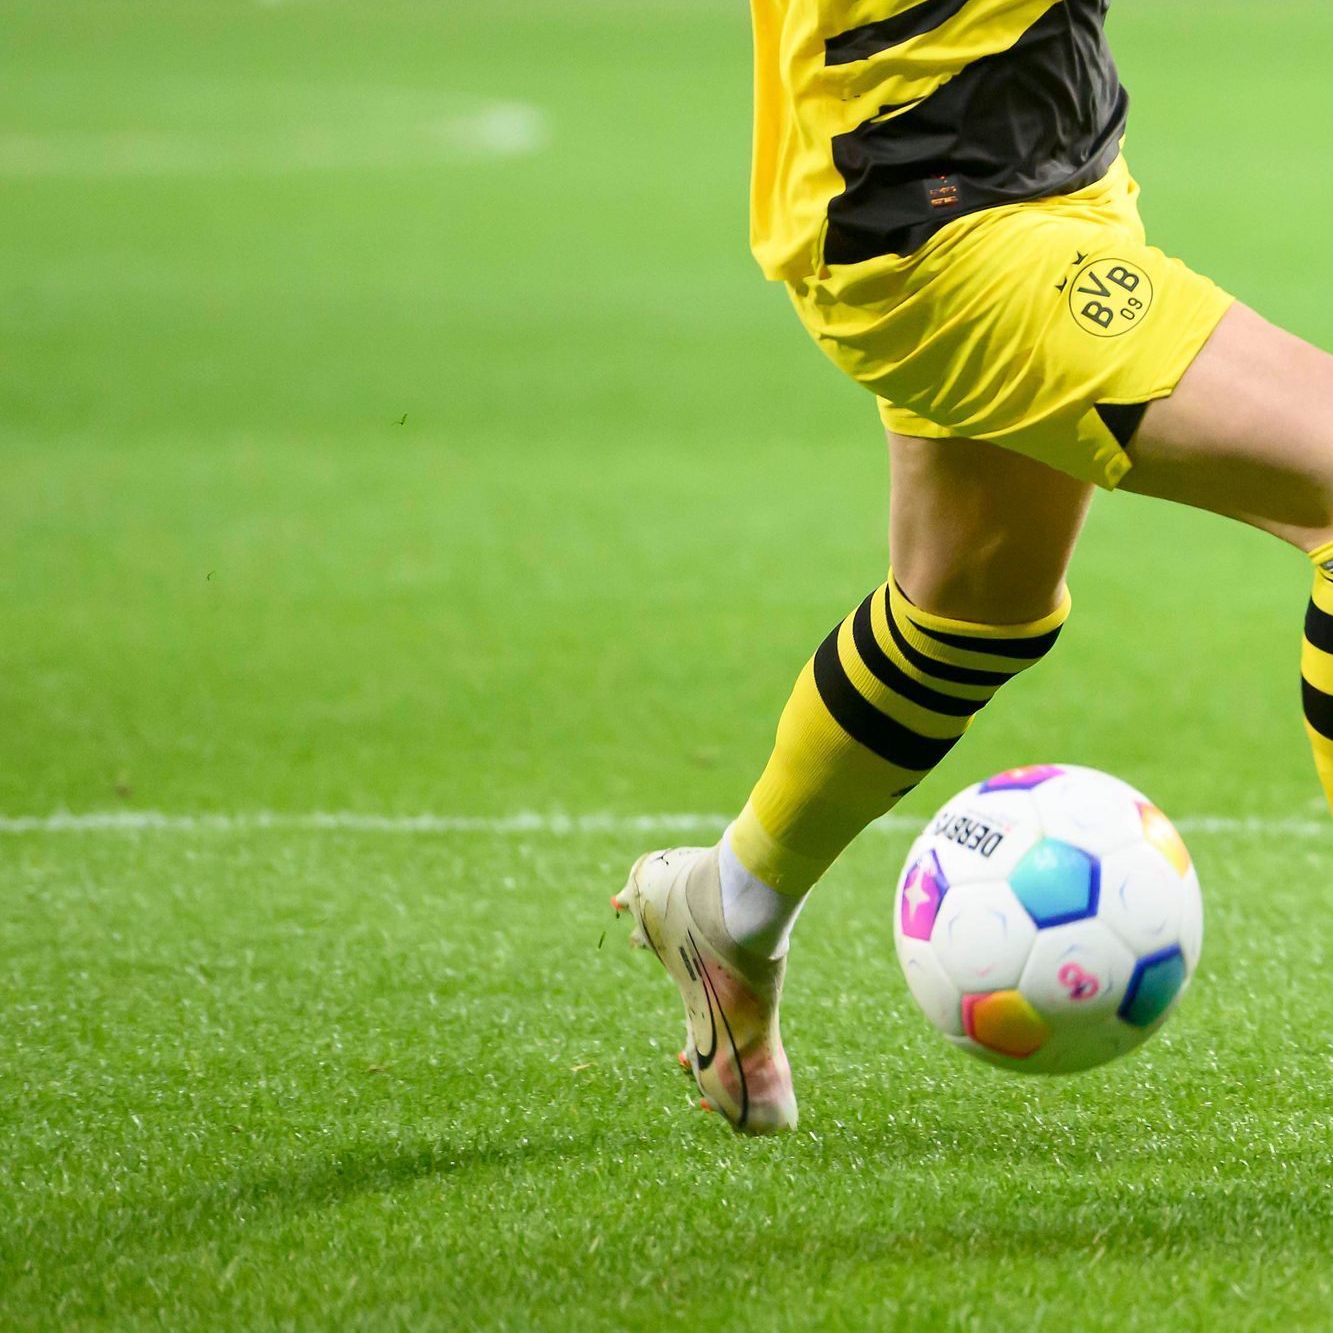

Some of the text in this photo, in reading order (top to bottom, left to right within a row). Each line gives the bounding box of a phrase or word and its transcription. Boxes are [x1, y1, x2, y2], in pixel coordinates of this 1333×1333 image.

[1077, 266, 1140, 329] BVB
[1120, 297, 1143, 320] 09
[935, 813, 1004, 858] DERBY
